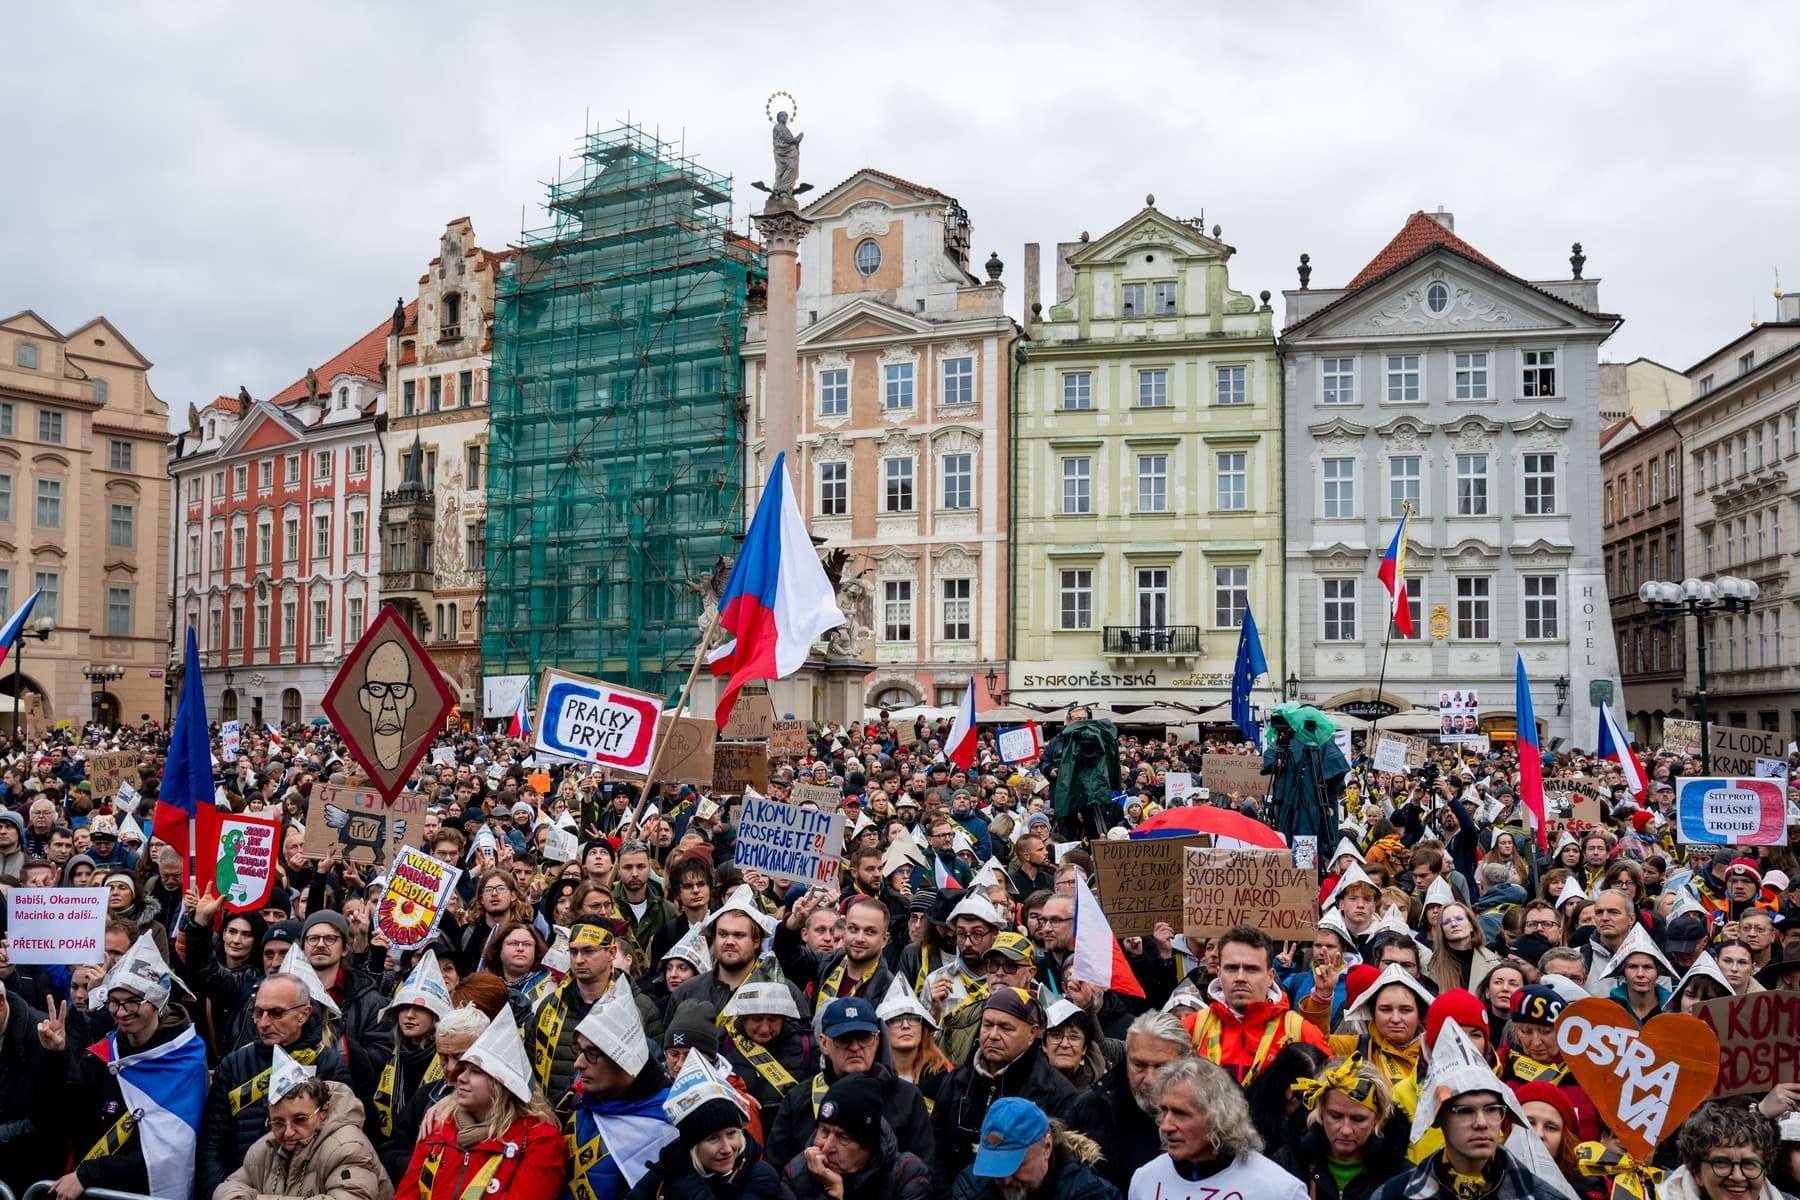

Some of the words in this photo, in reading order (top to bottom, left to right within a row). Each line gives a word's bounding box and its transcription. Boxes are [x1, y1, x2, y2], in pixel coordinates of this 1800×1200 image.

[1583, 586, 1595, 666] HOTEL
[1023, 669, 1156, 686] STAROMĚSTSKÁ
[566, 699, 634, 730] PRACKY
[1674, 721, 1702, 729] NEJSME
[569, 724, 623, 752] PRYČ!
[1716, 731, 1784, 757] ZLODĚJ
[1713, 756, 1755, 776] KRADE
[319, 785, 342, 802] ČT
[1709, 792, 1727, 801] ŠTÍT
[1729, 793, 1754, 801] PROTI
[742, 799, 754, 822] A
[756, 801, 797, 832] KOMU
[800, 808, 831, 835] TÍM
[1710, 803, 1754, 815] HLÁSNÉ
[244, 826, 271, 838] JAKO
[351, 820, 377, 839] TV
[1114, 859, 1184, 878] VEČERNÍČK
[1186, 850, 1217, 868] KDO
[1262, 852, 1280, 868] NA
[816, 859, 838, 883] NE!
[1186, 868, 1259, 887] SVOBODU
[1149, 879, 1170, 892] ZLO
[49, 895, 100, 905] Okamuro,
[1186, 888, 1224, 905] TOHO
[1233, 886, 1281, 908] NÁROD
[15, 910, 55, 920] Macinko
[379, 897, 430, 945] SVOBODU
[1258, 909, 1314, 930] ZNOVA
[13, 936, 55, 949] PŘETEKL
[58, 936, 96, 949] POHÁR
[1728, 993, 1800, 1041] KOM
